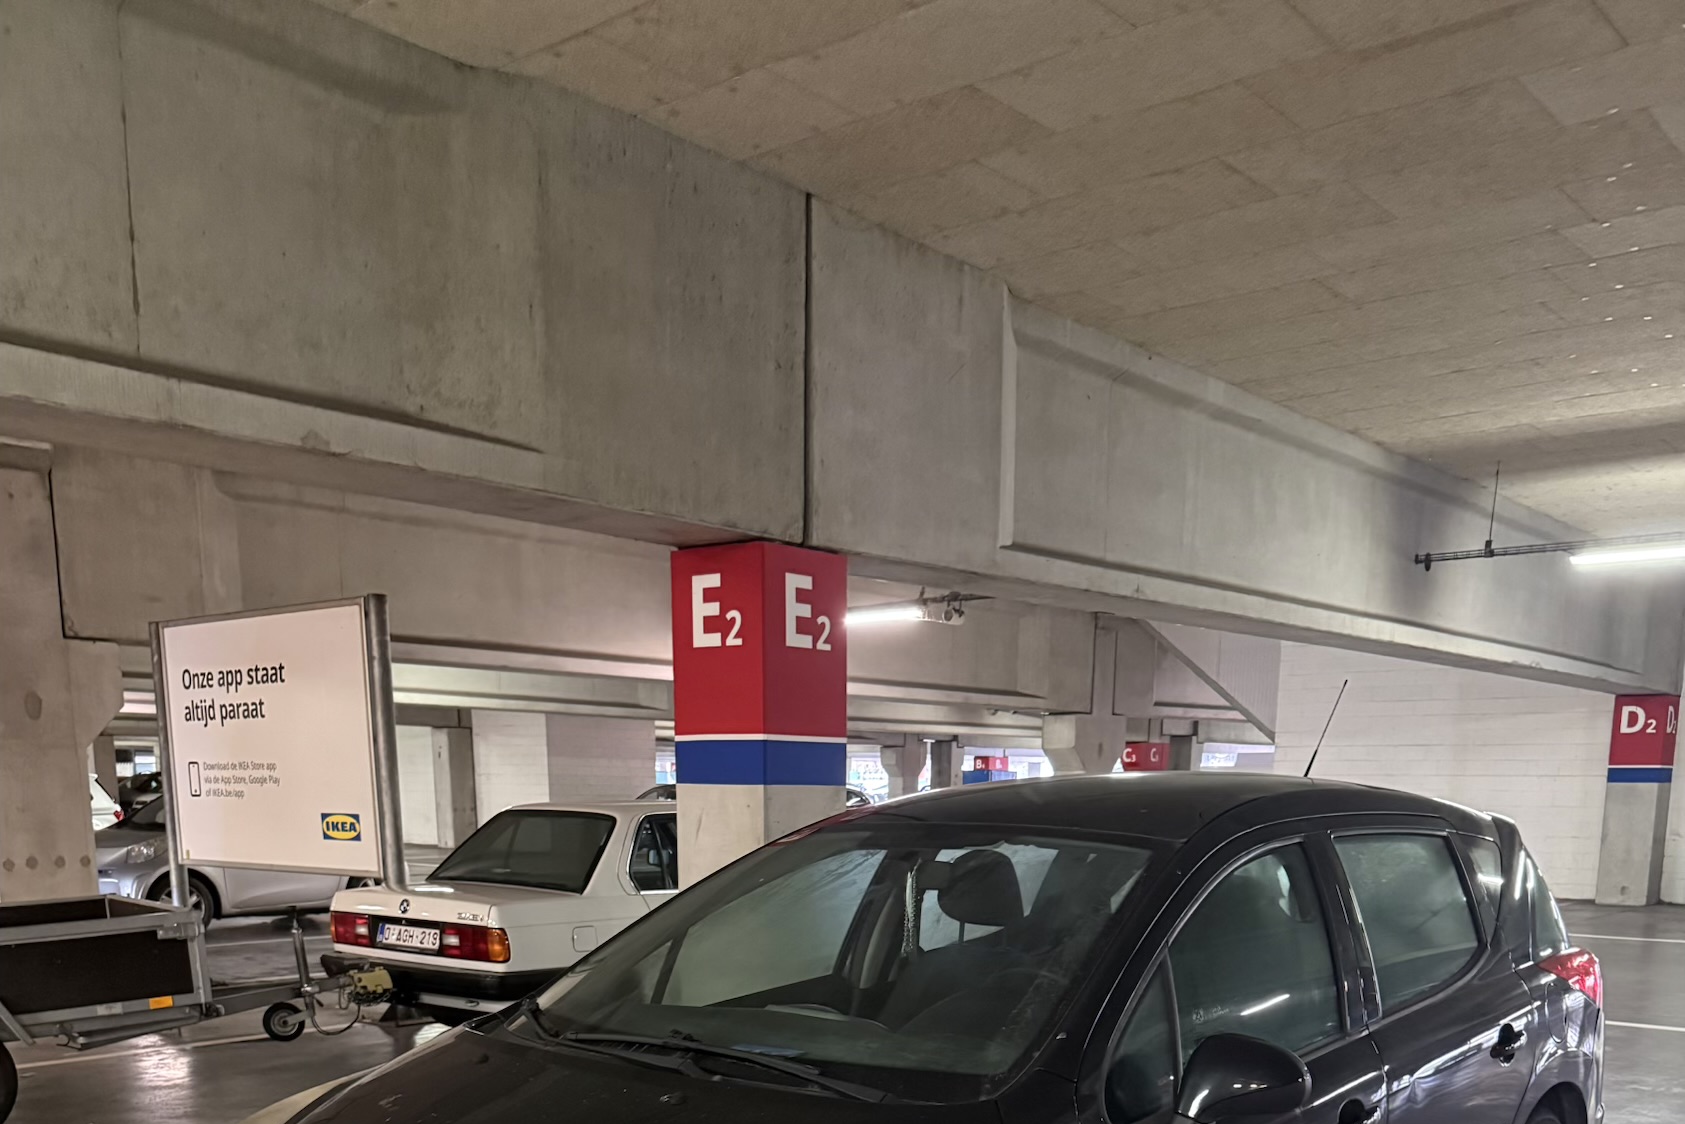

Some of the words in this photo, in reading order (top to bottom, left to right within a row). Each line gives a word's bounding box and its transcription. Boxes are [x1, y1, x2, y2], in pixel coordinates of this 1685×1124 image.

[692, 572, 743, 649] E2
[785, 572, 832, 651] E2
[182, 668, 214, 690] Onze
[217, 668, 243, 694] app
[247, 662, 286, 685] staat
[184, 698, 216, 728] altijd
[219, 698, 266, 727] paraat
[1620, 705, 1657, 734] D2
[203, 761, 230, 771] Download
[230, 761, 238, 771] de
[238, 761, 250, 771] IKEA
[250, 760, 265, 771] Store
[266, 762, 277, 772] app
[204, 775, 212, 784] via
[213, 775, 220, 784] de
[220, 775, 232, 786] App
[248, 774, 268, 787] Google
[268, 774, 281, 787] Play
[205, 788, 212, 797] of
[325, 820, 358, 833] IKEA
